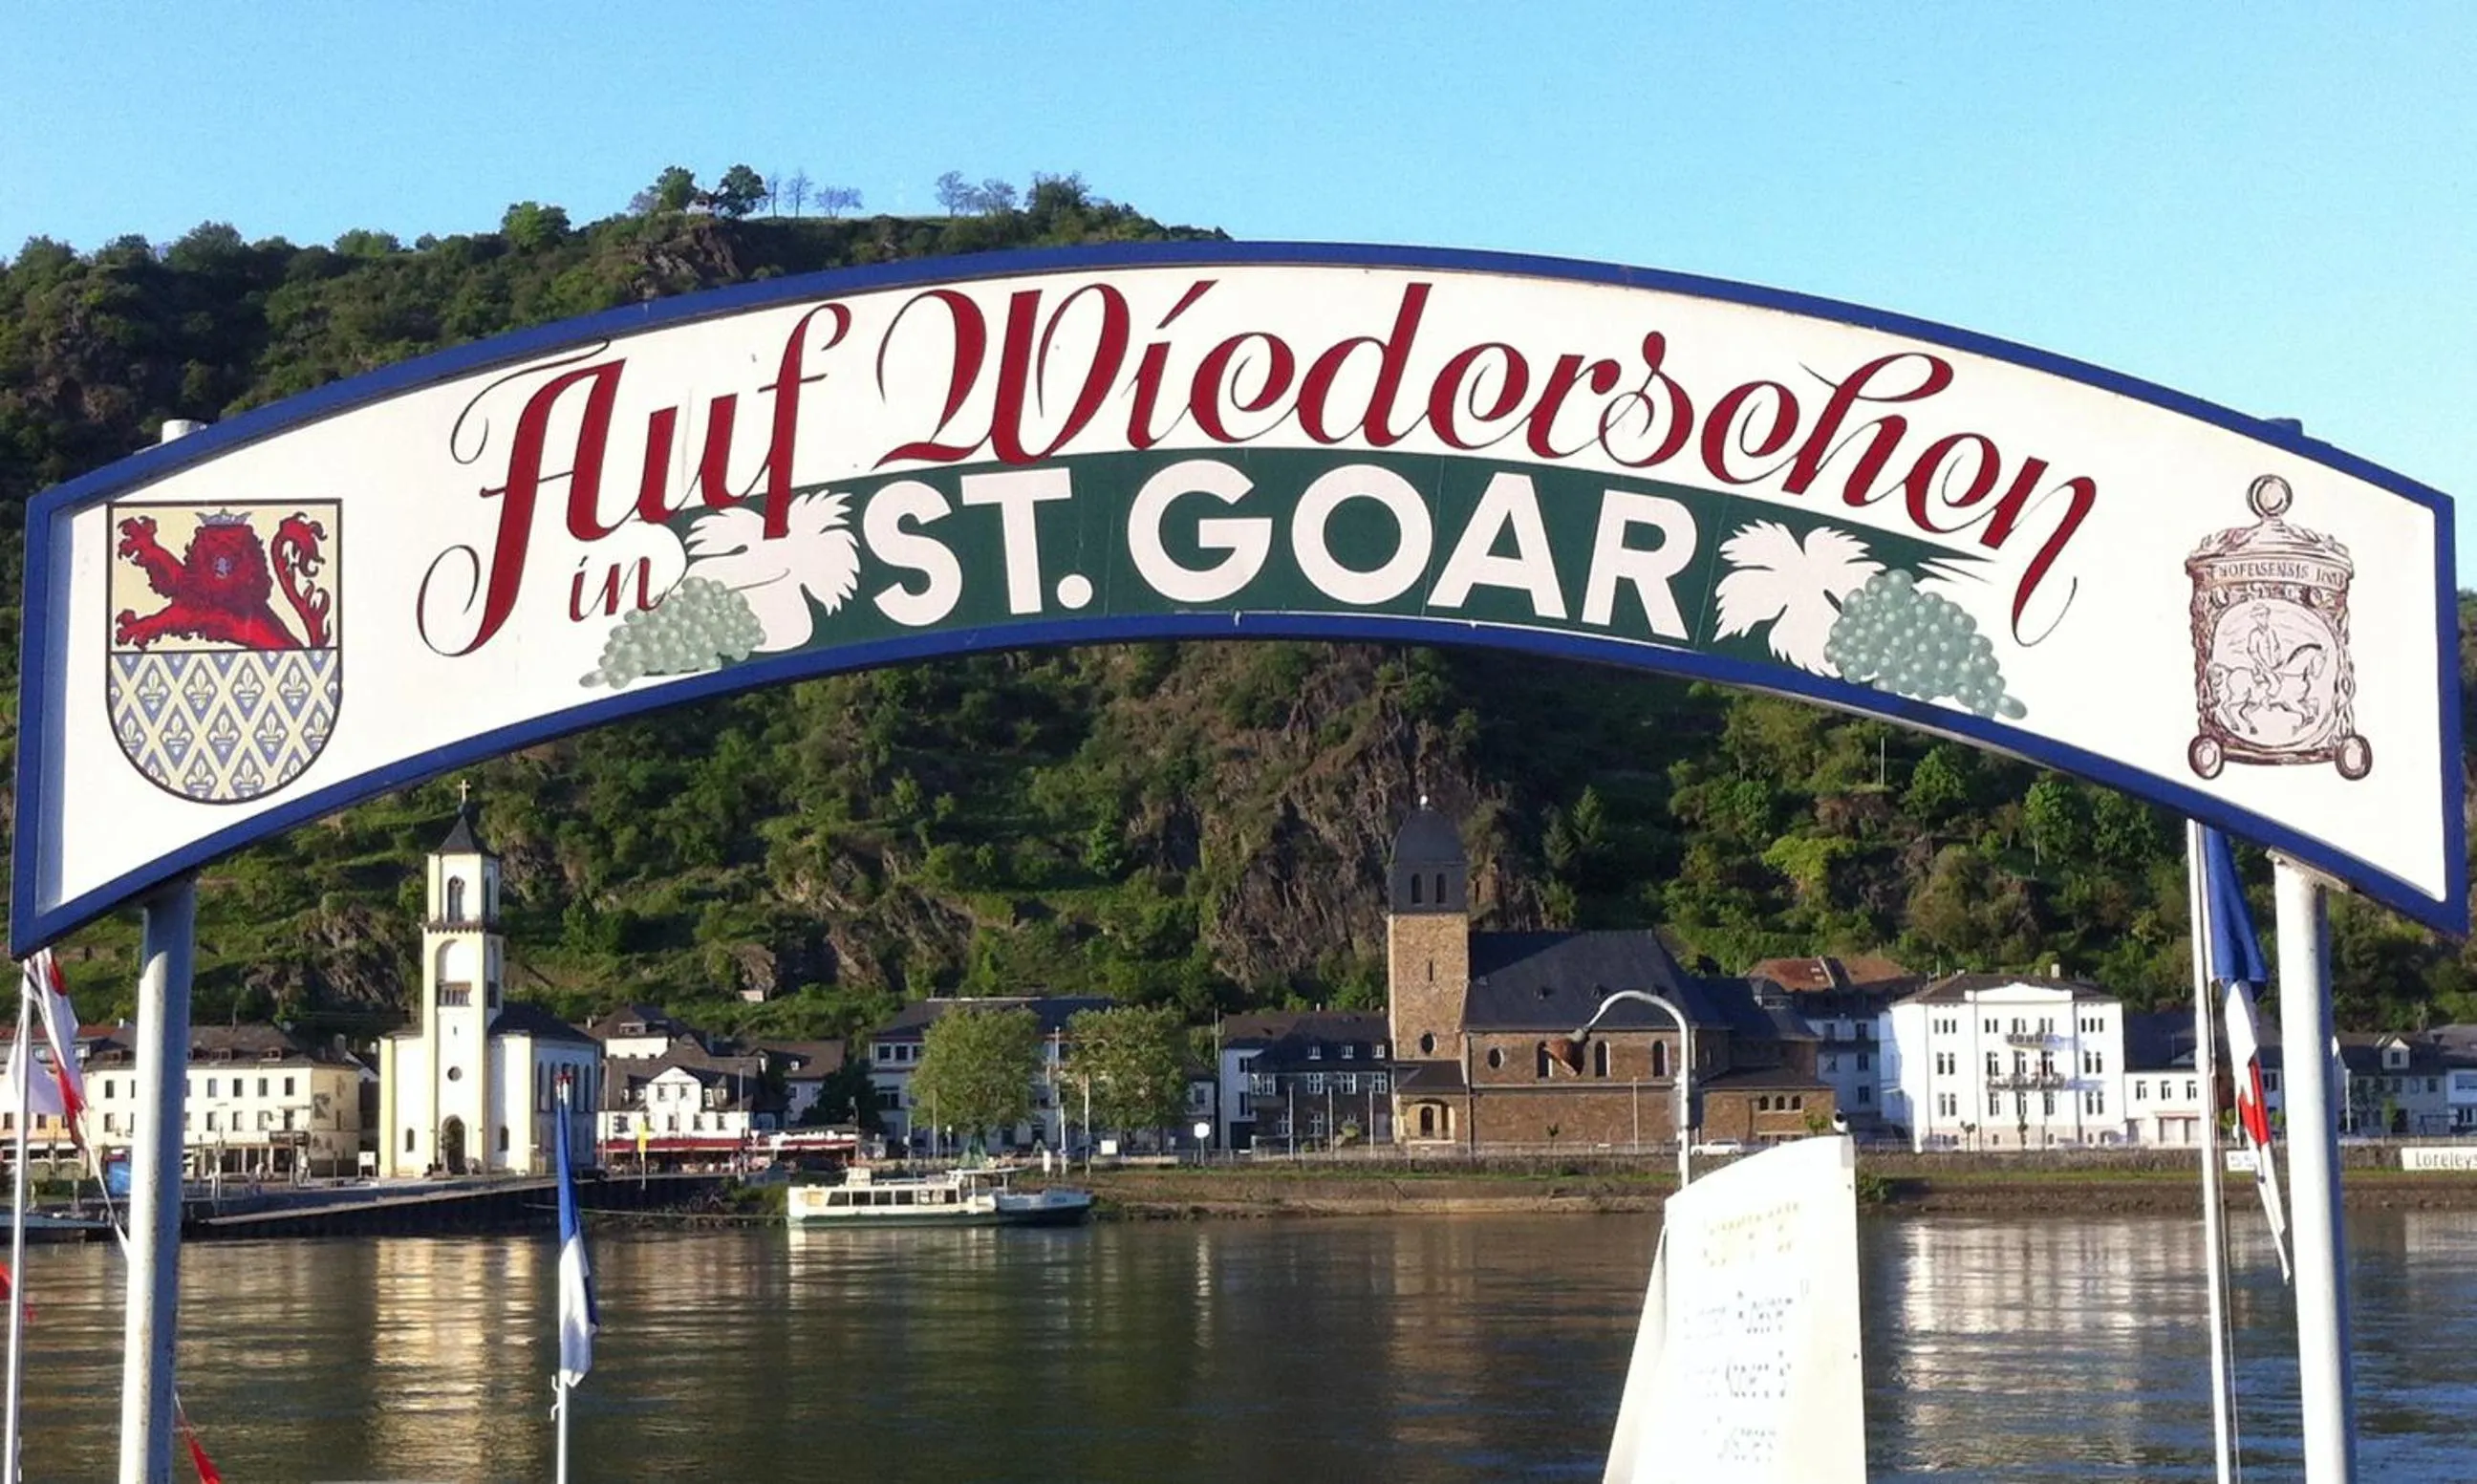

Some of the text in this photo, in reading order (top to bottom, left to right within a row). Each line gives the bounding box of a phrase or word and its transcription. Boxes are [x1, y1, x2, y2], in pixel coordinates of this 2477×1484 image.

[417, 279, 2098, 656] Auf Wiedersehen
[569, 459, 1699, 642] in ST. GOAR
